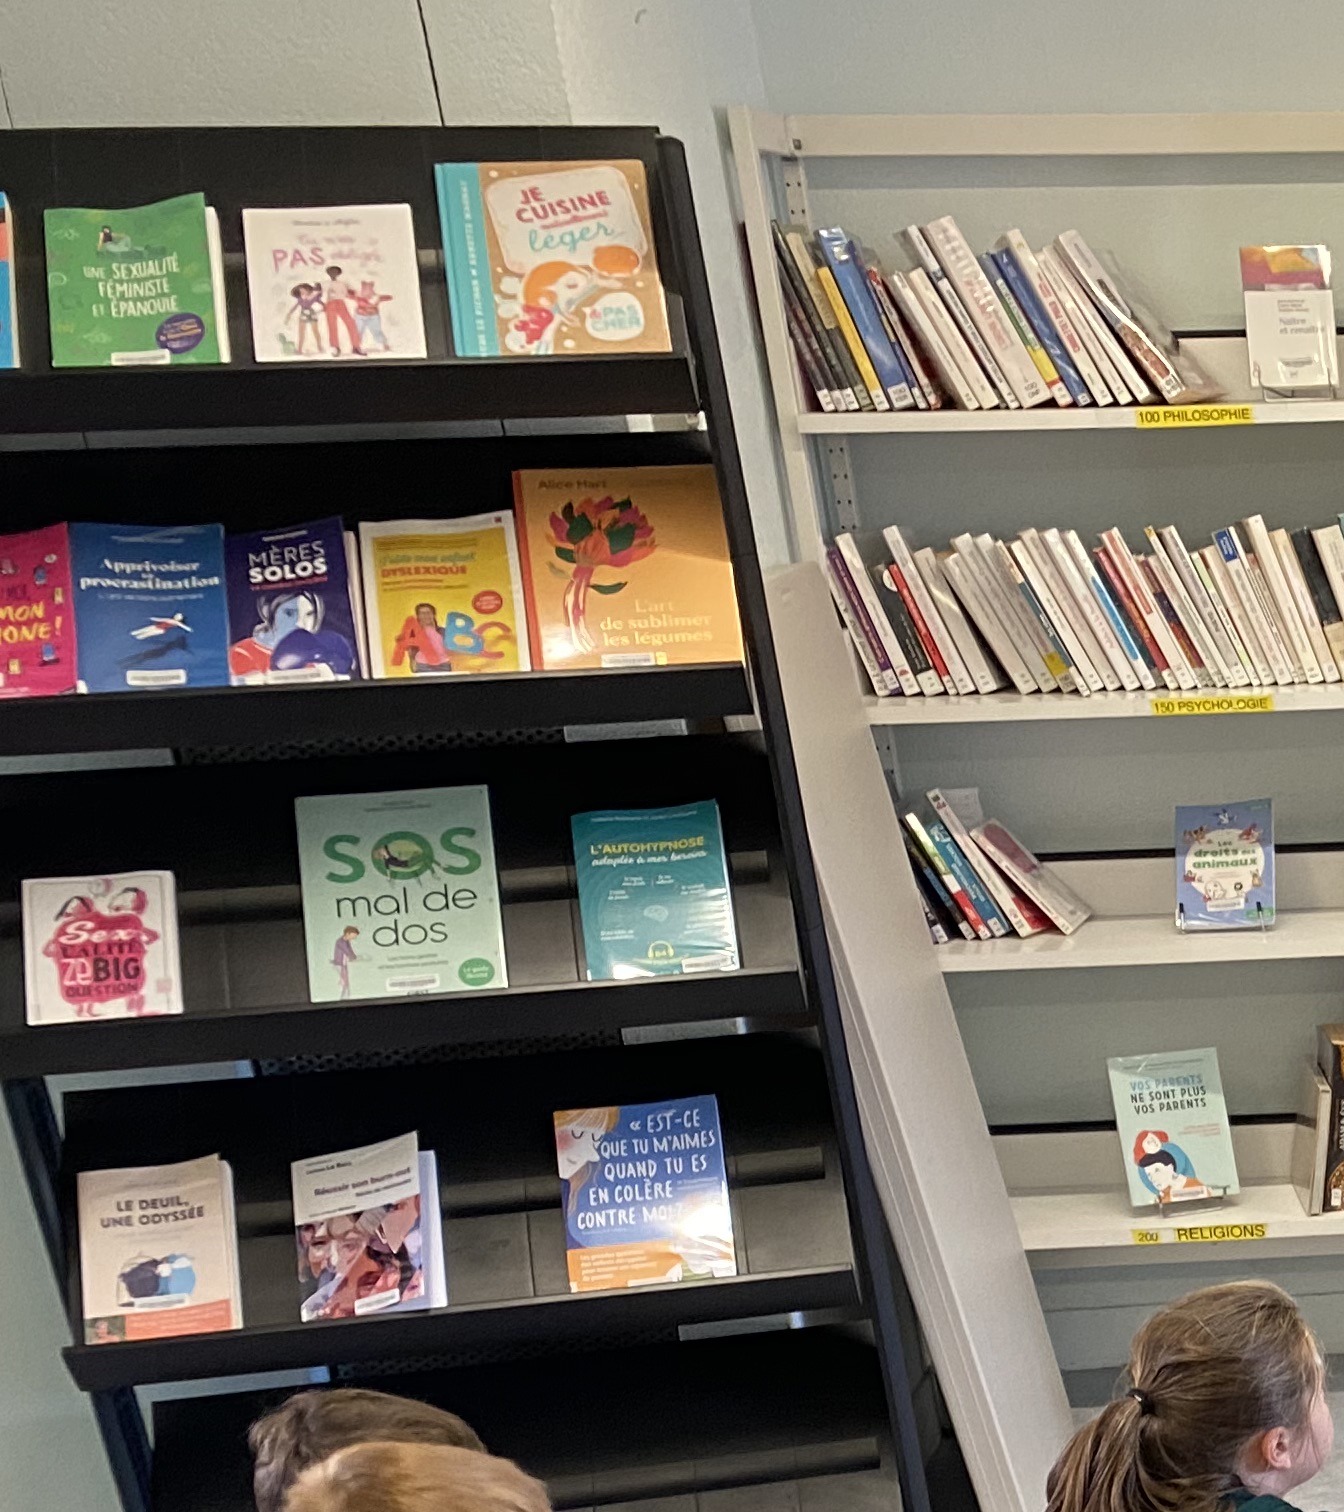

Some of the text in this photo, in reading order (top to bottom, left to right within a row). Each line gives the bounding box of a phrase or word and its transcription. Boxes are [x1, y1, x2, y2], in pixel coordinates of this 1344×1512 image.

[520, 186, 546, 204] JE
[516, 190, 612, 224] CUISINE
[83, 252, 180, 280] UNE SEXUALITÉ
[272, 247, 326, 272] PAS
[98, 277, 170, 298] FÉMINISTE
[92, 295, 179, 318] ET ÉPANOUIE
[603, 304, 639, 318] PAS
[592, 316, 642, 332] CHER
[1139, 408, 1250, 424] 100 PHILOSOPHIE
[538, 480, 574, 490] Alice
[248, 540, 324, 568] MÈRES
[104, 558, 200, 574] Apprivoiser
[248, 557, 328, 584] SOLOS
[380, 565, 468, 578] DYSLEXIQUE
[80, 576, 220, 590] procrastination
[600, 616, 624, 631] de
[603, 629, 713, 647] les légumes
[1154, 698, 1268, 714] 150 PSYCHOLOGIE
[323, 826, 482, 884] SOS
[590, 836, 704, 856] L'AUTOHYPNOSE
[1194, 848, 1238, 858] droits
[1192, 858, 1257, 868] animaux
[336, 884, 478, 918] mal de
[372, 919, 448, 947] dos
[93, 956, 140, 982] BIG
[64, 984, 138, 998] QUESTION
[1130, 1074, 1203, 1092] VOS PARENTS
[1130, 1086, 1206, 1104] NE SONT PLUS
[1134, 1098, 1206, 1115] VOS PARENTS
[646, 1108, 700, 1133] EST-CE
[600, 1129, 716, 1160] QUE TU M'AIMES
[604, 1154, 707, 1182] QUAND TU ES
[589, 1187, 609, 1206] EN
[614, 1178, 673, 1204] COLÈRE
[116, 1200, 134, 1212] LE
[100, 1206, 204, 1228] UNE ODYSSÉE
[577, 1208, 636, 1230] CONTRE
[1138, 1224, 1266, 1242] 200 RELIGIONS
